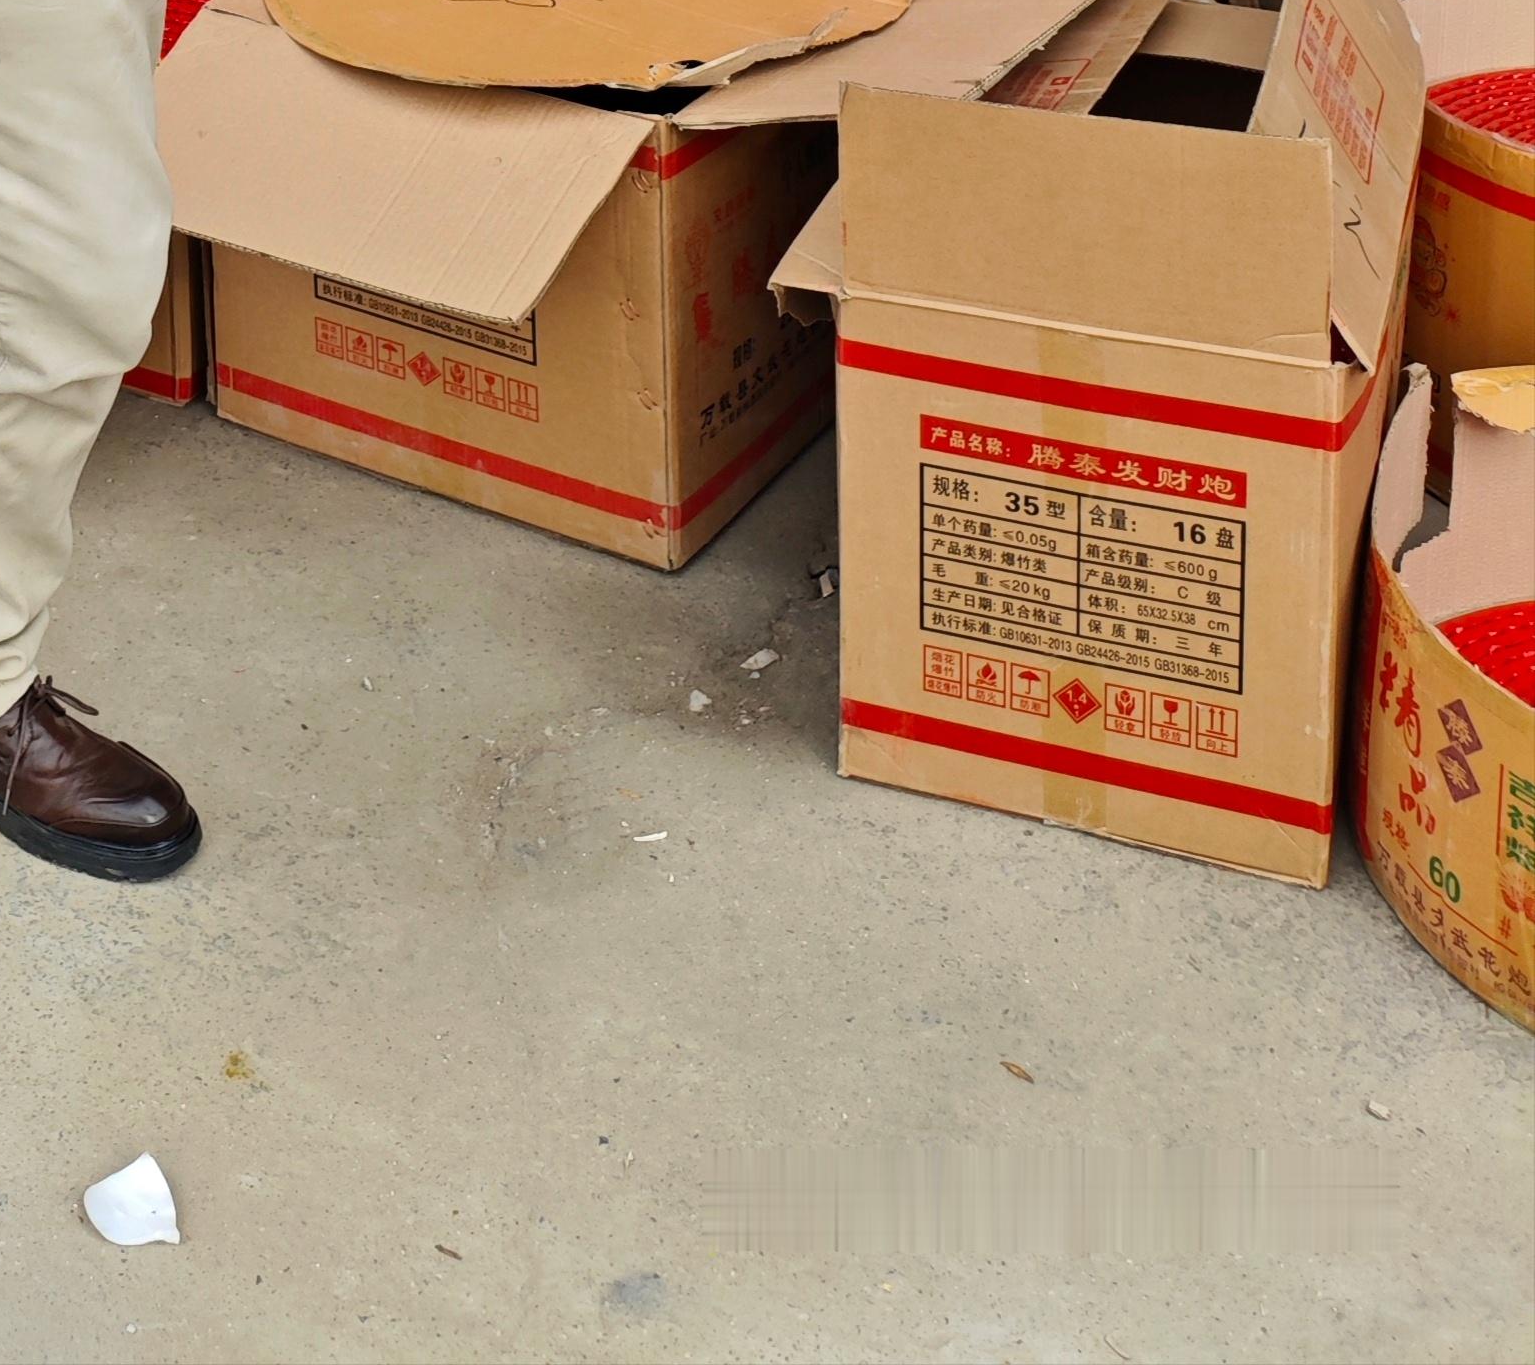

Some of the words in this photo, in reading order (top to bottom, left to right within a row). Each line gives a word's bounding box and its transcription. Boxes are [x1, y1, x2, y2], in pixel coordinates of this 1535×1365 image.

[322, 282, 367, 307] 执行标准:
[930, 426, 1011, 458] 产品名称:
[1027, 443, 1237, 501] 腾泰发财炮
[932, 475, 980, 502] 规格:
[1004, 491, 1040, 516] 35
[1046, 500, 1066, 520] 型
[932, 512, 997, 539] 单个药量:
[1001, 528, 1057, 553] ≤0.05g
[1088, 504, 1138, 533] 含量:
[1173, 521, 1207, 545] 16
[1215, 527, 1235, 550] 盘
[931, 537, 997, 565] 产品类别:
[1001, 550, 1047, 574] 爆竹类
[1085, 543, 1154, 569] 箱含药量:
[931, 587, 997, 613] 生产日期:
[1001, 600, 1063, 627] 见合格证
[1084, 568, 1155, 595] 产品级别:
[1177, 585, 1189, 600] C
[1206, 590, 1222, 608] 级
[1087, 593, 1126, 615] 体积:
[1136, 603, 1196, 627] 65X32.5X38
[1207, 619, 1230, 634] cm
[931, 611, 997, 637] 执行标准:
[999, 626, 1073, 654] GB10631-2013
[1076, 642, 1150, 669] GB24426-2015
[1153, 658, 1230, 685] GB31368-2015
[931, 651, 956, 667] 烟花
[1175, 636, 1190, 652] 三
[1208, 641, 1223, 658] 年
[975, 690, 998, 706] 防火
[1065, 689, 1088, 705] 1.4
[1205, 738, 1229, 753] 向上
[1428, 854, 1462, 904] 60
